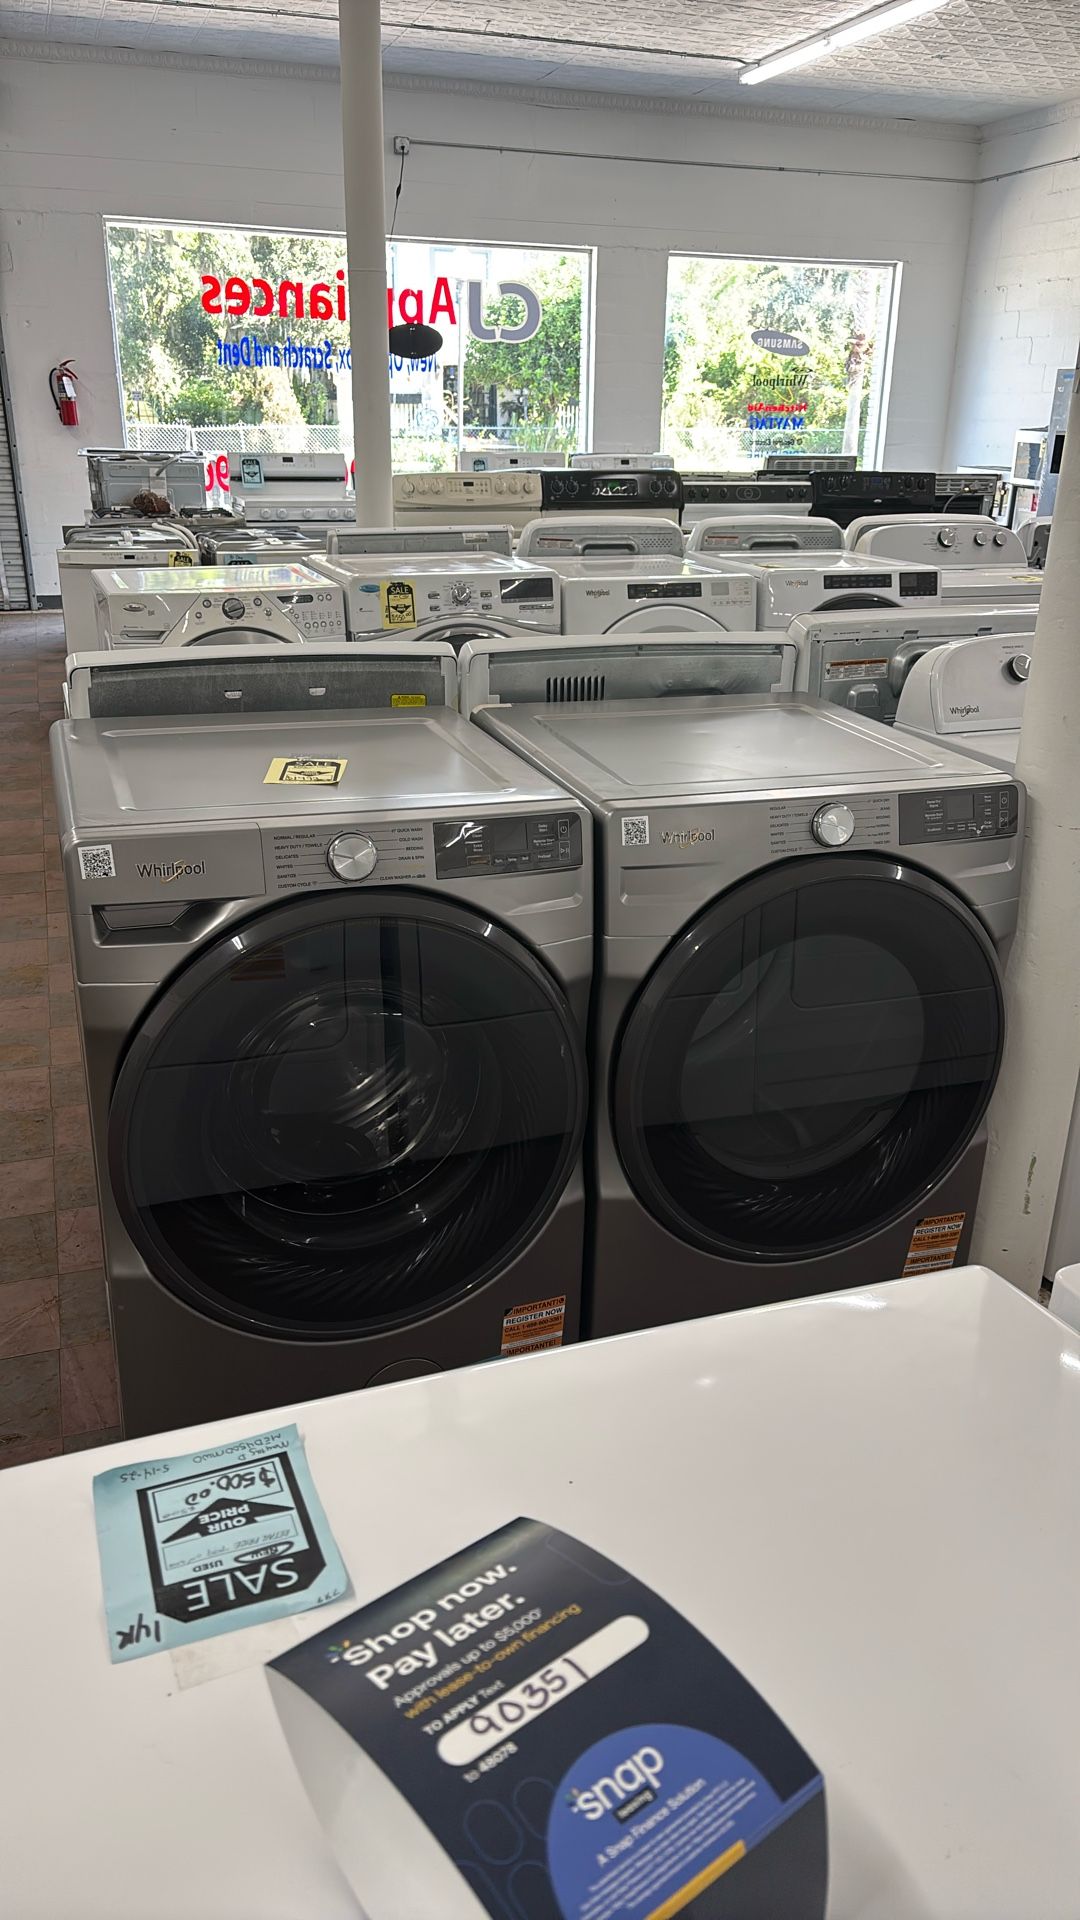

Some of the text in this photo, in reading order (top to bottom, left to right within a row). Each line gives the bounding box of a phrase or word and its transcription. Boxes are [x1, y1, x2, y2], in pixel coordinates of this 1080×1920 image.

[390, 586, 410, 595] SALE
[950, 705, 980, 717] Whirlpool
[661, 829, 715, 845] Whirlpool
[136, 860, 206, 880] Whirlpool
[916, 1225, 946, 1235] REGISTER
[506, 1307, 563, 1326] REGISTER NOW
[505, 1324, 520, 1333] CALL
[120, 1465, 170, 1483] 5-14-25
[198, 1504, 250, 1525] PRICE
[207, 1517, 247, 1534] OUR
[192, 1546, 279, 1573] NEW USED
[182, 1558, 299, 1612] SALE
[343, 1564, 518, 1666] Shop now.
[365, 1593, 526, 1691] Pay later.
[404, 1603, 584, 1719] with lease-to-own financing
[393, 1661, 462, 1709] Approvals
[461, 1649, 481, 1665] up
[478, 1639, 496, 1652] to
[470, 1658, 590, 1735] 90351
[422, 1679, 505, 1736] TO APPLY Text
[462, 1769, 481, 1784] to
[577, 1746, 664, 1821] snap
[597, 1779, 708, 1868] A Snap Finance Solution
